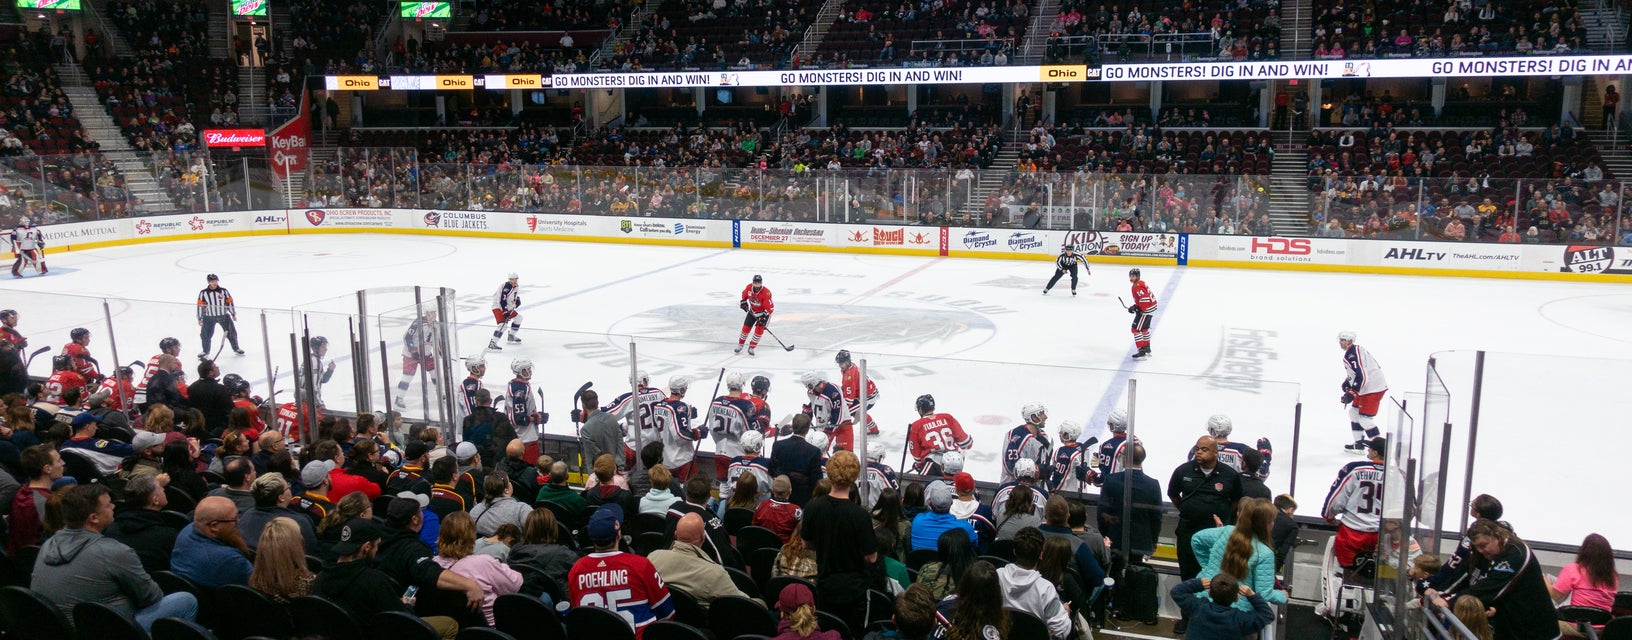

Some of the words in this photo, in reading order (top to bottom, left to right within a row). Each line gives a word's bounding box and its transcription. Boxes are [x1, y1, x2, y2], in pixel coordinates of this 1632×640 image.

[1106, 67, 1123, 78] GO
[1128, 66, 1206, 78] MONSTERS!
[1211, 65, 1234, 77] DIG
[1239, 65, 1253, 77] IN
[1257, 64, 1289, 76] AND
[1293, 63, 1328, 76] WIN!
[1432, 61, 1453, 74] GO
[1458, 60, 1553, 74] MONSTERS!
[1558, 59, 1586, 72] DIG
[1592, 59, 1610, 71] IN
[781, 73, 795, 83] GO
[799, 72, 863, 83] MONSTERS!
[866, 71, 886, 82] DIG
[889, 71, 901, 81] IN
[904, 71, 930, 81] AND
[934, 70, 962, 81] WIN!
[1048, 69, 1077, 77] Ohio
[1087, 68, 1101, 77] CAT
[345, 79, 370, 87] Ohio
[378, 79, 390, 87] CAT
[474, 78, 485, 86] CAT
[542, 77, 552, 85] CAT
[555, 76, 568, 86] GO
[571, 75, 626, 86] MONSTERS!
[628, 75, 645, 85] DIG
[648, 75, 659, 85] IN
[661, 74, 683, 85] AND
[686, 74, 710, 84] WIN!
[206, 133, 263, 144] Budweiser
[443, 212, 487, 220] COLUMBUS
[443, 219, 459, 229] BLUE
[621, 220, 631, 229] 811
[41, 230, 78, 241] MEDICAL
[81, 227, 117, 236] MUTUAL
[963, 234, 990, 244] Diamond
[1071, 230, 1098, 245] KID
[1120, 234, 1139, 242] SIGN
[1141, 235, 1153, 243] UP
[974, 239, 997, 249] Crystal
[1008, 236, 1035, 246] Diamond
[1020, 241, 1043, 250] Crystal
[1251, 237, 1311, 255] HDS
[1072, 241, 1102, 252] ATION
[1121, 242, 1150, 251] TODAY!
[1453, 253, 1520, 261] TheAHL.com/AHLTV
[1571, 247, 1608, 264] ALT
[1579, 262, 1603, 273] 99.1
[846, 386, 852, 395] 5
[514, 403, 525, 413] 53
[923, 418, 948, 431] TUULOLA
[925, 428, 956, 451] 36
[1008, 449, 1018, 460] 23
[1100, 454, 1111, 466] 28
[1055, 462, 1066, 474] 90
[578, 569, 629, 591] POEHLING
